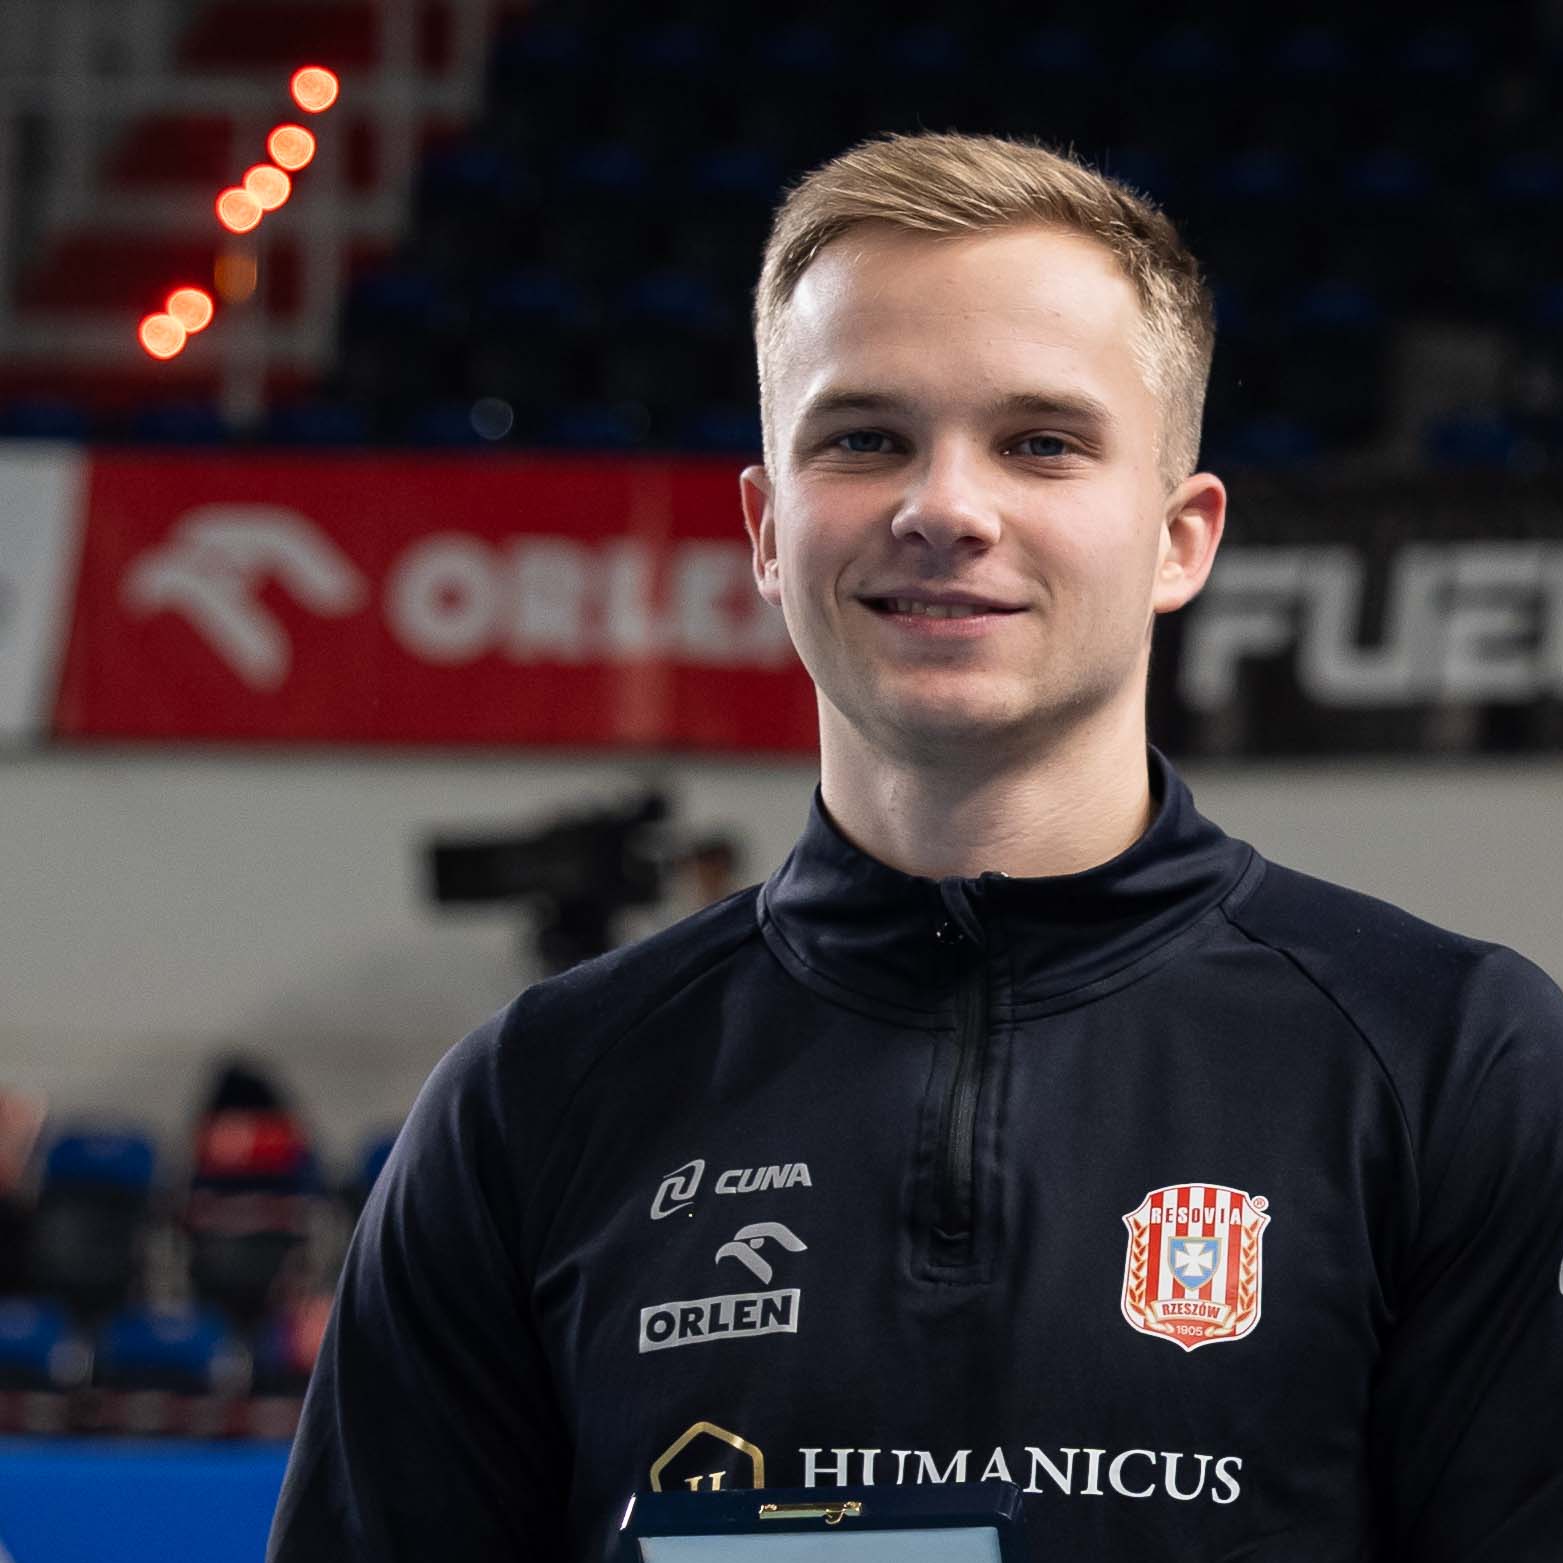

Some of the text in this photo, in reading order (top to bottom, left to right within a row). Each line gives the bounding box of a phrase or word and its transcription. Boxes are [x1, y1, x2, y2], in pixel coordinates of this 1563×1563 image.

[388, 530, 800, 668] ORLE
[715, 1163, 813, 1194] CUNA
[1150, 1206, 1243, 1225] RESOVIA
[645, 1294, 793, 1343] ORLEN
[1162, 1302, 1220, 1319] RZESZÓW
[1175, 1325, 1204, 1337] 1905
[799, 1446, 1242, 1504] HUMANICUS
